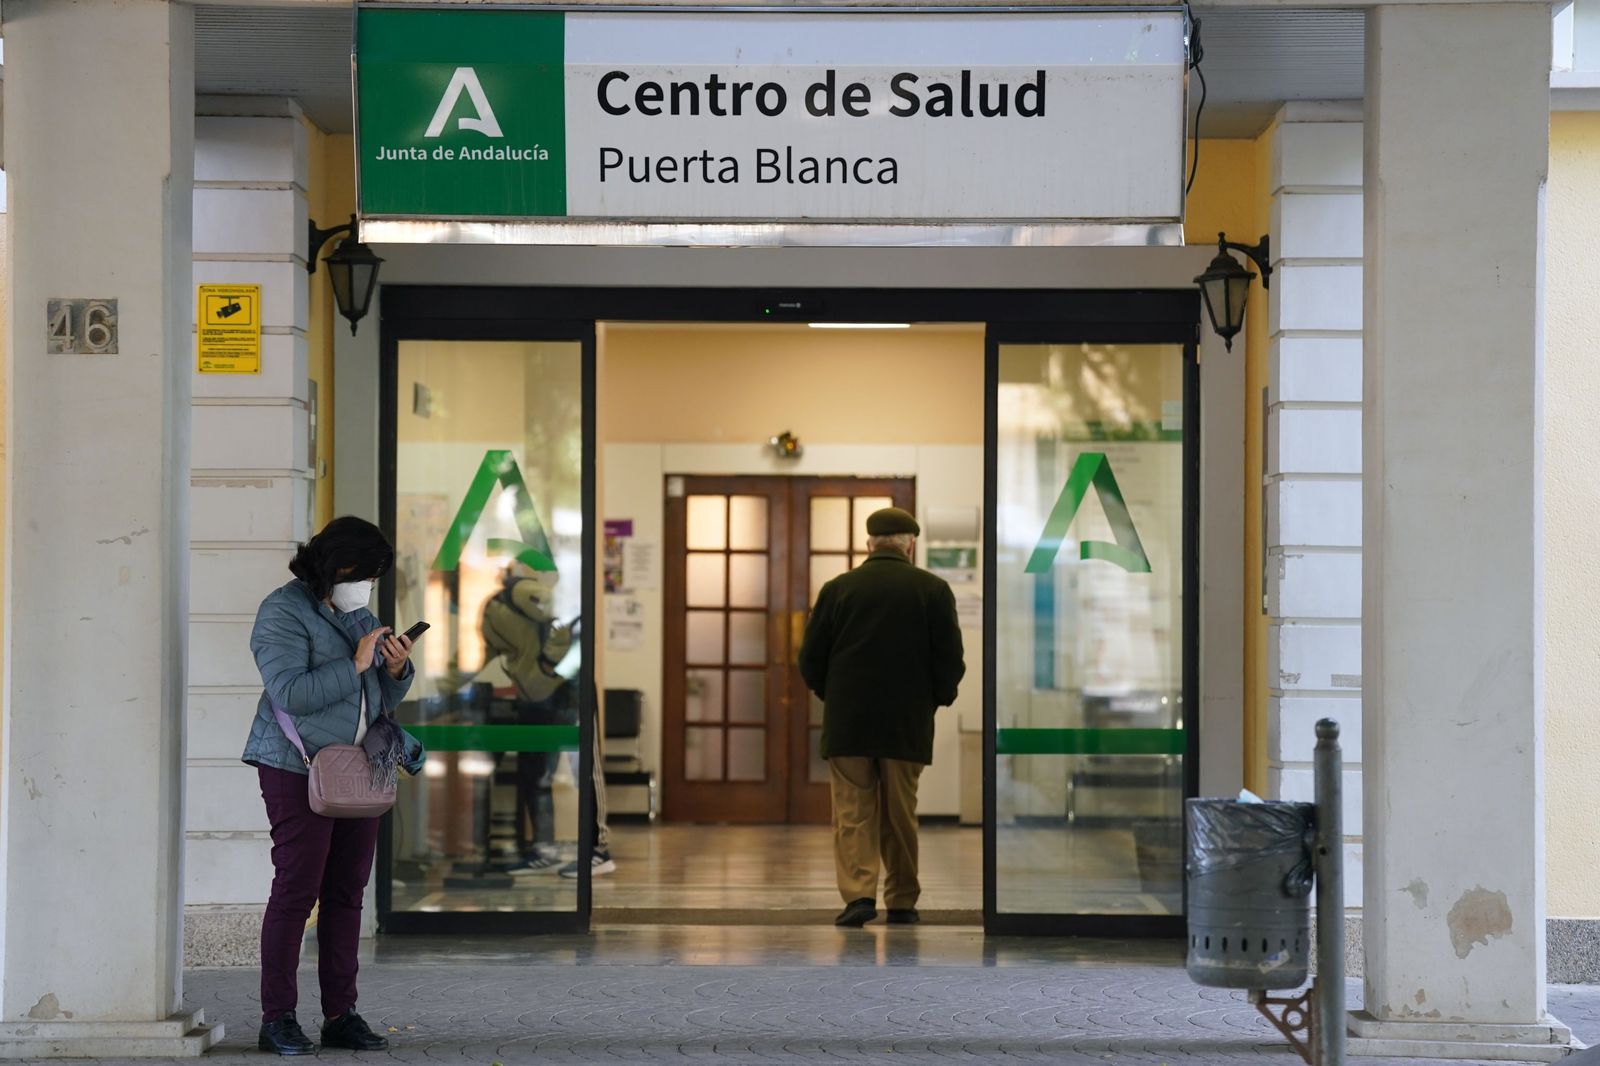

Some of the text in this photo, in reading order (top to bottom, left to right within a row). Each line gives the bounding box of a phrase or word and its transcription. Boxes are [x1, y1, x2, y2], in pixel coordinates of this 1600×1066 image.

[597, 70, 1046, 118] Centro de Salud
[375, 144, 549, 161] Junta de Andalucía
[599, 145, 898, 184] Puerta Blanca
[48, 303, 112, 350] 46
